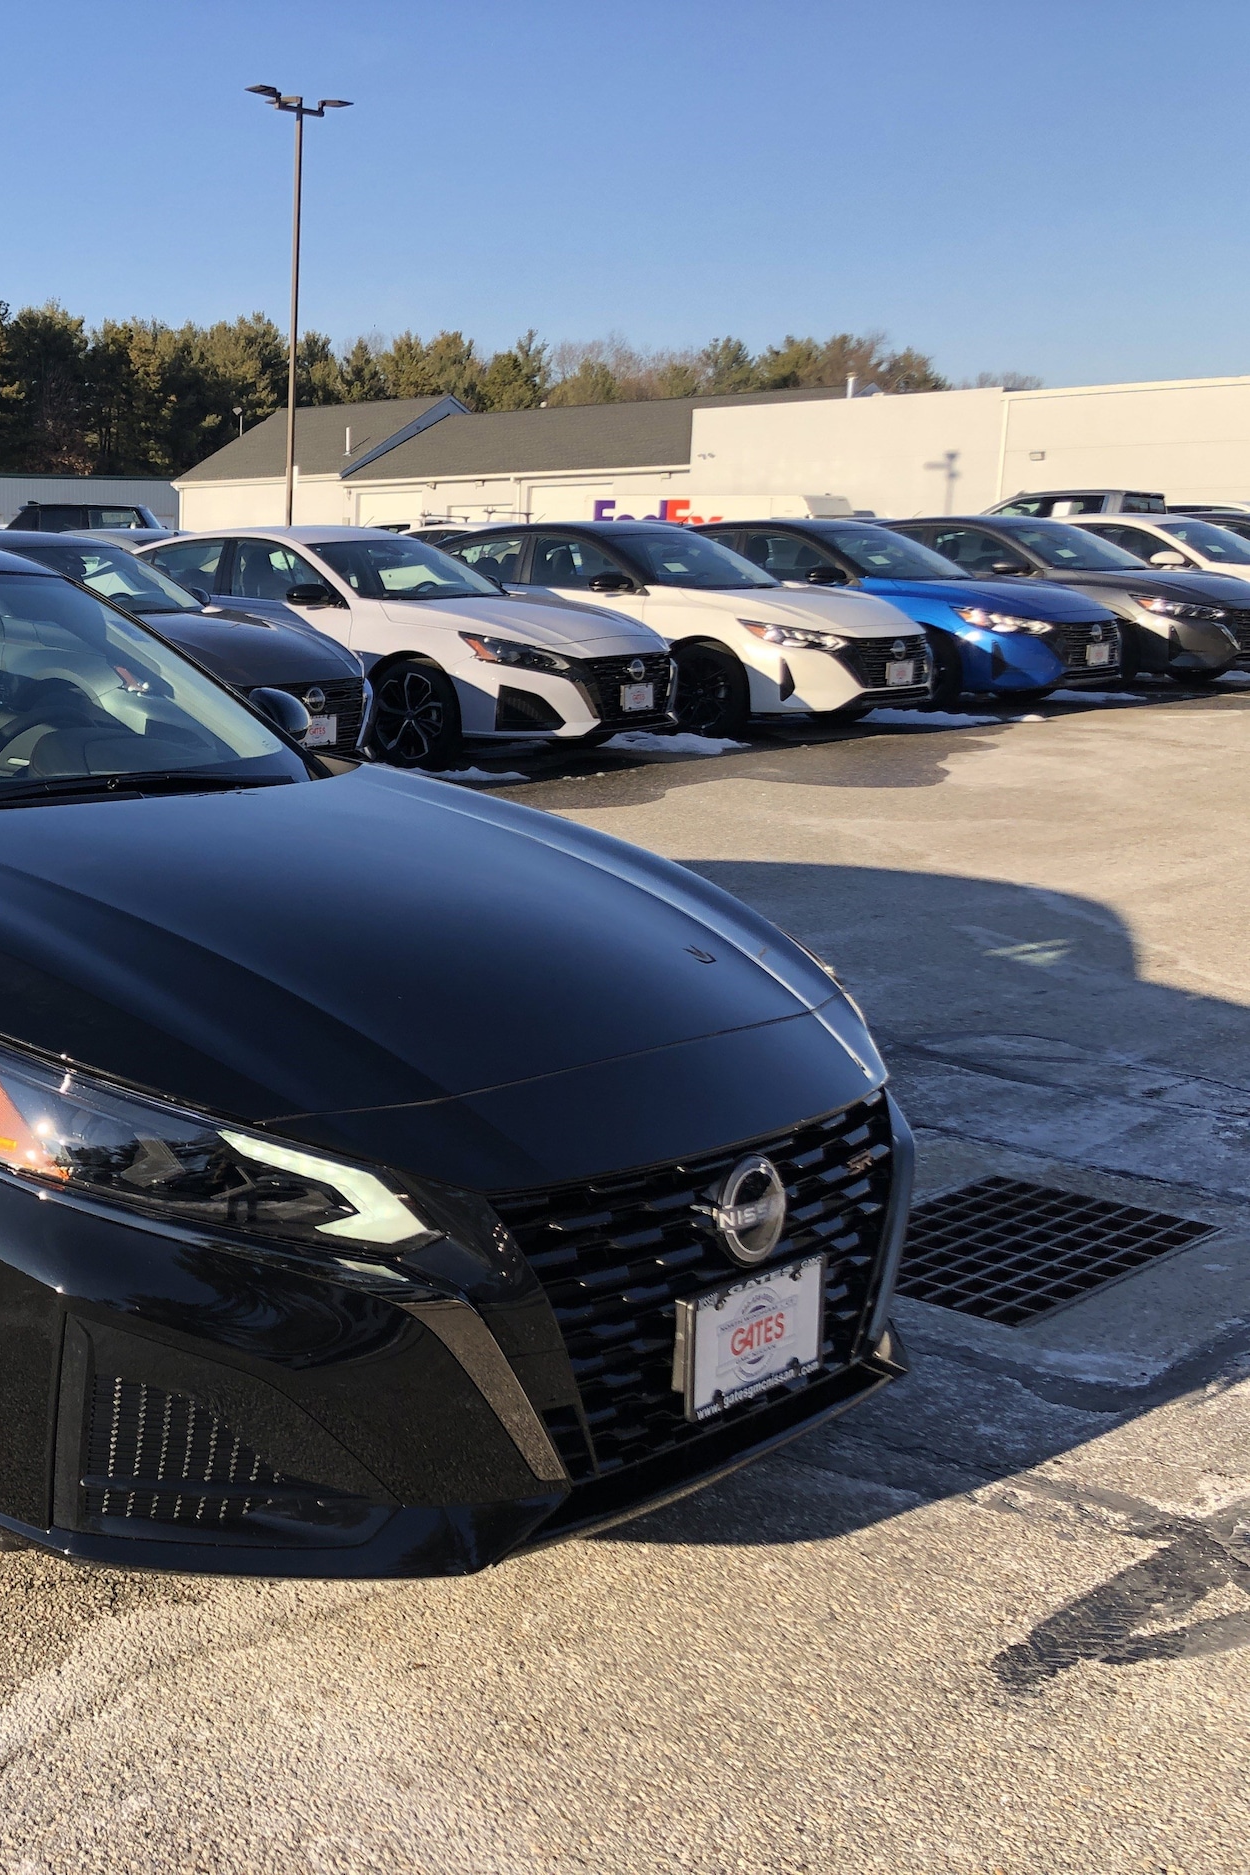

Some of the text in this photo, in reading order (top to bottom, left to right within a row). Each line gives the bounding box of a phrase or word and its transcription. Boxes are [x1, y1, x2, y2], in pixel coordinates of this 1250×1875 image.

[594, 499, 724, 526] FdE
[718, 1197, 776, 1229] NISS
[731, 1312, 784, 1356] GATES
